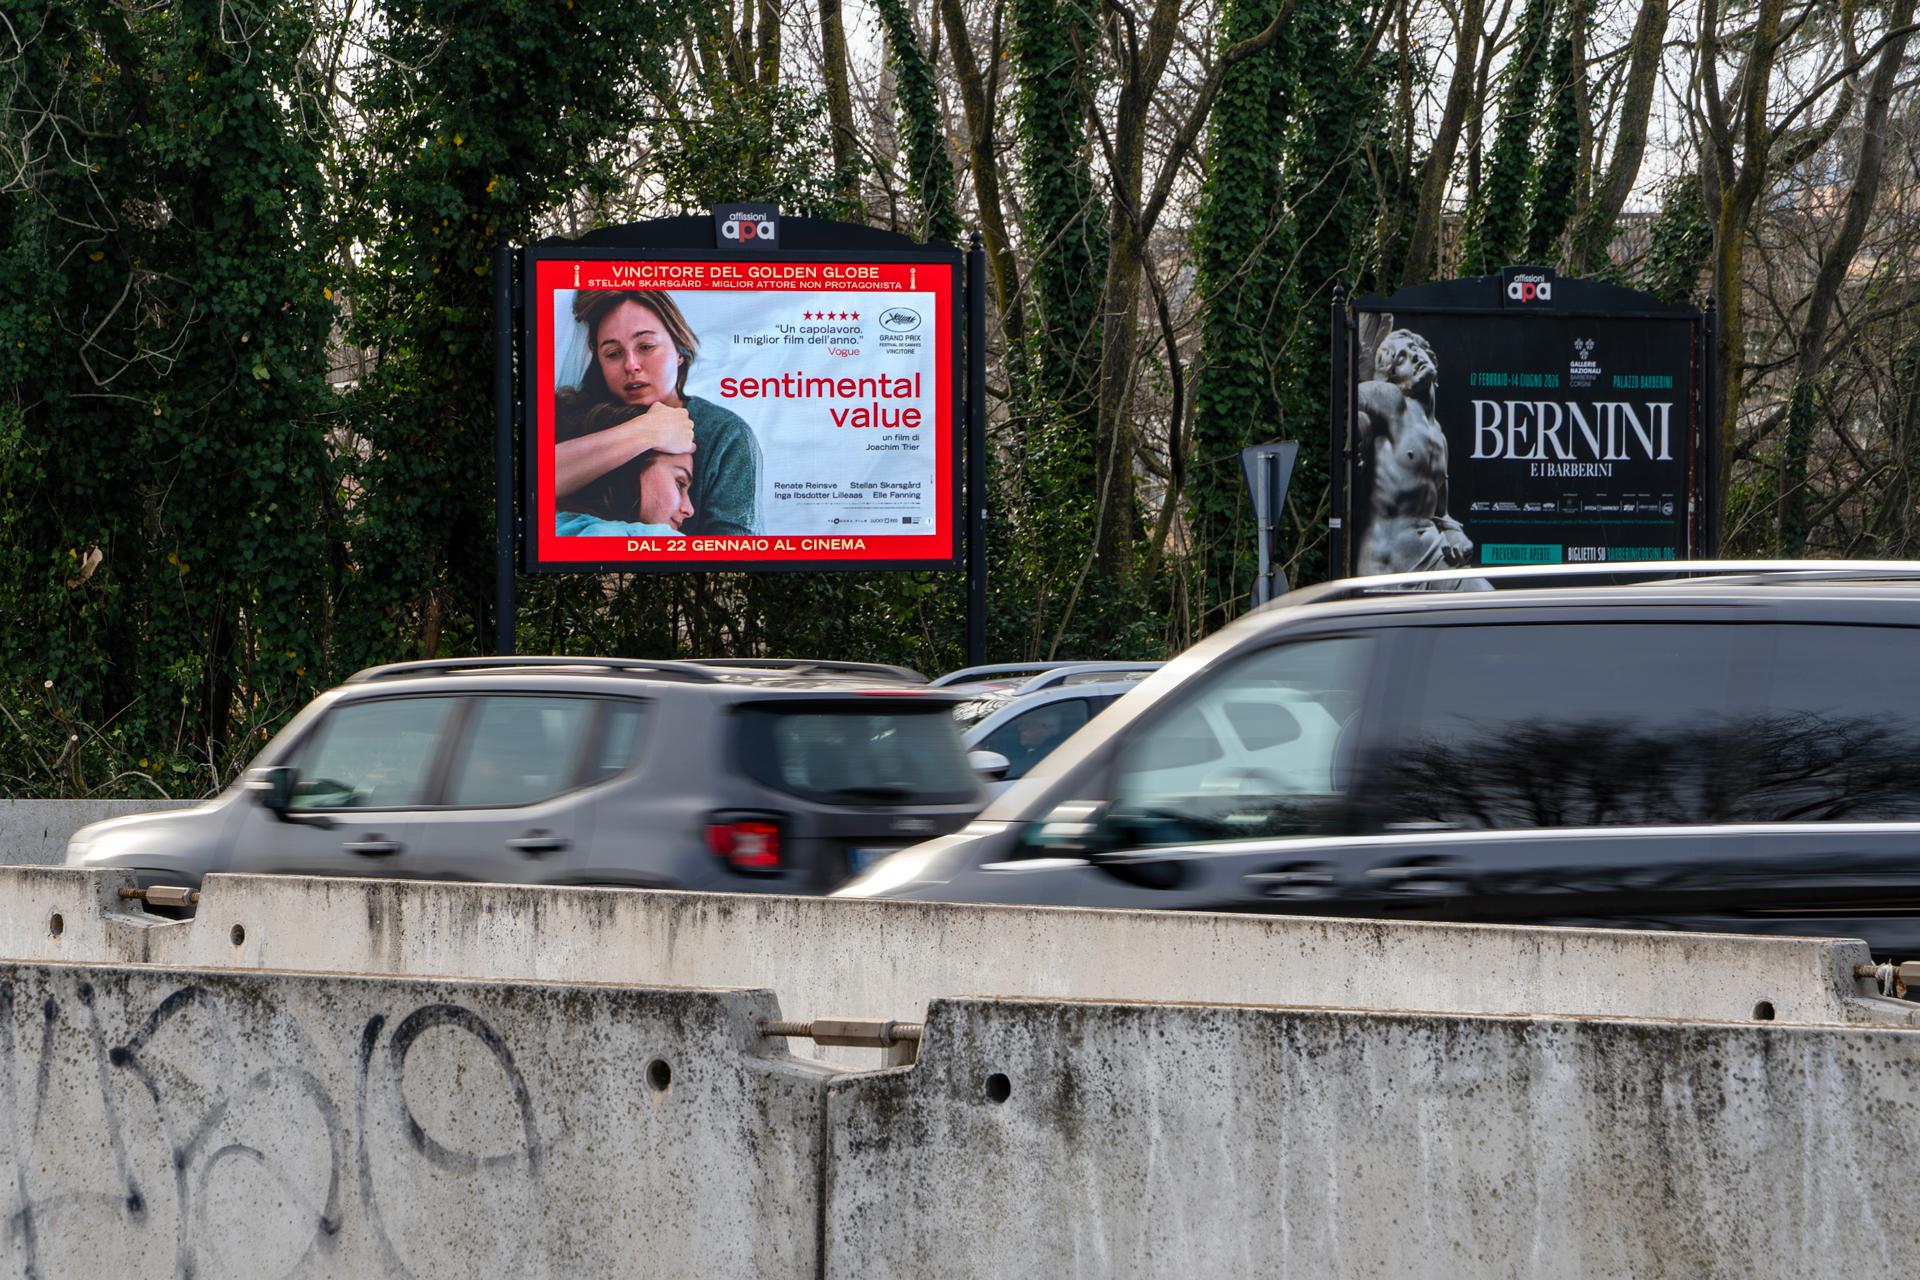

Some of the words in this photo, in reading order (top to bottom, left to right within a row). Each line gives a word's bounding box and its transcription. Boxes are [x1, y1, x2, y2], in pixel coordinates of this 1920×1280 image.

[729, 212, 766, 221] affissioni
[721, 220, 775, 244] apa
[612, 266, 704, 278] VINCITORE
[710, 266, 742, 278] DEL
[748, 266, 816, 278] GOLDEN
[822, 267, 880, 278] GLOBE
[638, 278, 702, 288] SKARSGÅRD
[824, 282, 902, 290] PROTAGONISTA
[1514, 274, 1544, 283] affissioni
[1508, 282, 1551, 302] apa
[733, 335, 740, 344] Il
[743, 335, 780, 346] miglior
[783, 335, 804, 344] film
[828, 347, 860, 358] Vogue
[720, 371, 921, 399] sentimental
[1544, 375, 1560, 388] 2026
[1613, 376, 1638, 388] PALAZZO
[1640, 376, 1673, 388] BARBERINI
[830, 402, 922, 428] value
[1470, 400, 1674, 460] BERNINI
[1530, 463, 1538, 476] E
[1548, 463, 1612, 477] BARBERINI
[880, 482, 921, 491] Skarsgård
[774, 492, 792, 500] Inga
[793, 492, 830, 500] Ibsdotter
[832, 492, 863, 500] Lilleaas
[889, 492, 921, 500] Fanning
[627, 541, 662, 551] DAL
[666, 540, 686, 551] 22
[692, 540, 768, 551] GENNAIO
[774, 540, 796, 550] AL
[801, 539, 866, 550] CINEMA
[1568, 547, 1596, 560] BIGLIETTI
[1598, 547, 1606, 560] SU
